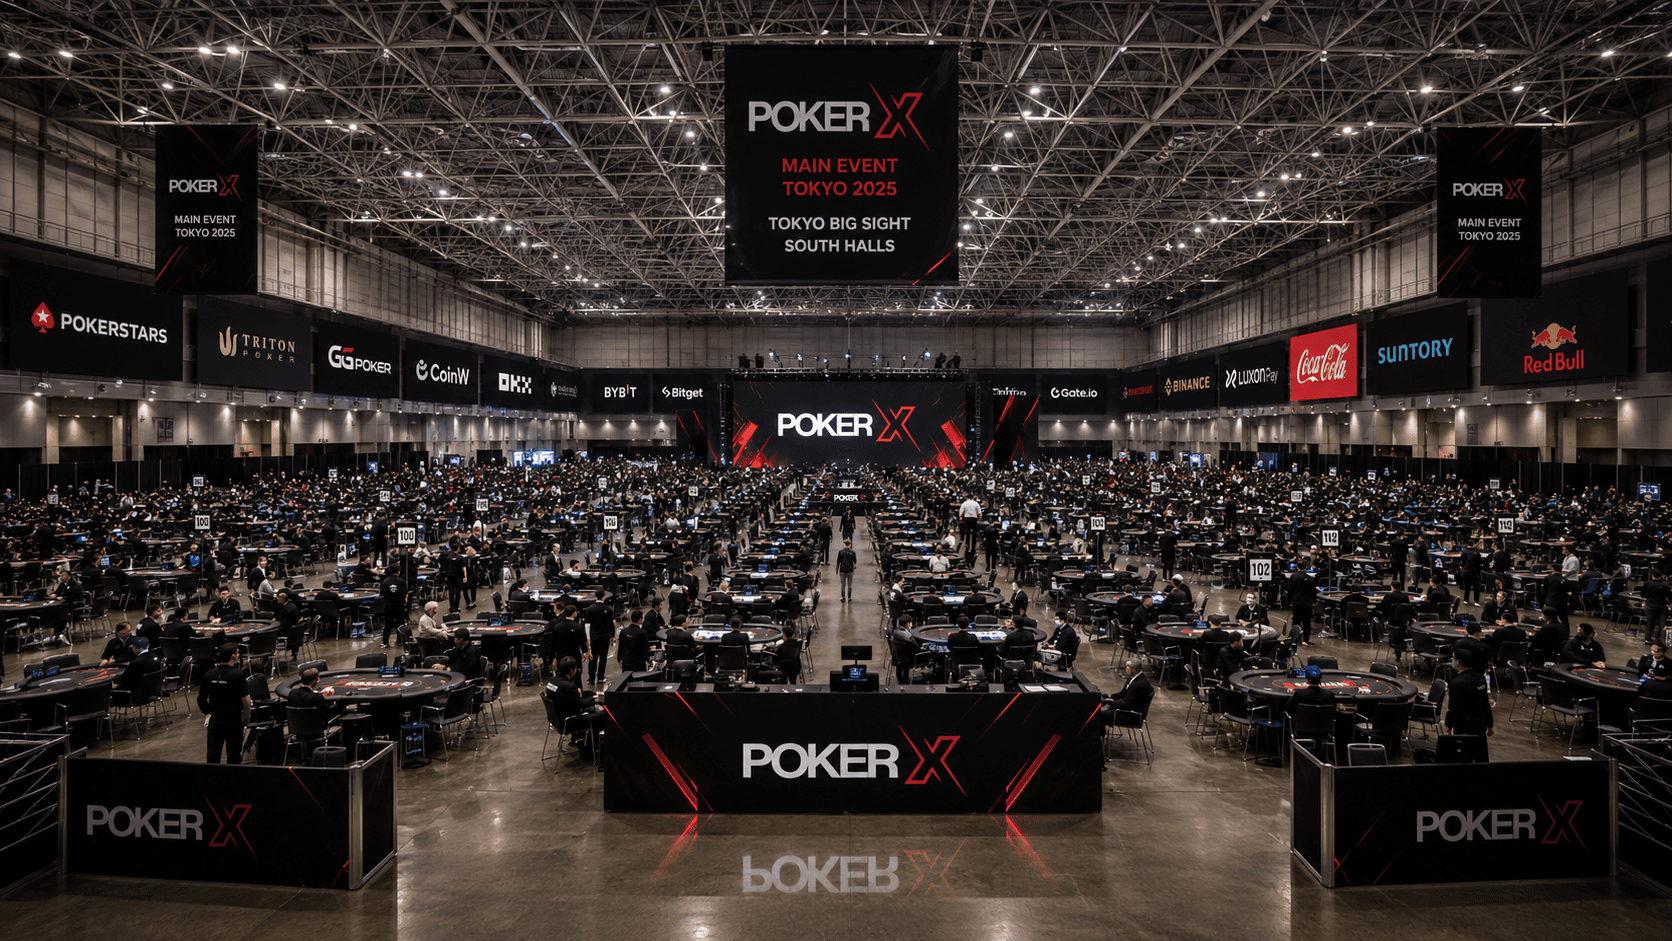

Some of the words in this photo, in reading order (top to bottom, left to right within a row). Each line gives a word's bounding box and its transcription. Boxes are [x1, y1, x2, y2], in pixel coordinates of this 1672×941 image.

[749, 101, 870, 132] POKER
[782, 158, 831, 173] MAIN
[837, 158, 899, 173] EVENT
[169, 179, 217, 193] POKER
[782, 181, 847, 196] TOKYO
[853, 181, 897, 196] 2025
[1452, 183, 1503, 197] POKER
[174, 215, 200, 224] MAIN
[203, 215, 236, 224] EVENT
[768, 217, 825, 230] TOKYO
[830, 217, 857, 230] BIG
[862, 217, 911, 230] SIGHT
[1457, 218, 1485, 227] MAIN
[1488, 218, 1522, 227] EVENT
[175, 228, 209, 237] TOKYO
[211, 228, 236, 237] 2025
[1458, 231, 1494, 241] TOKYO
[1496, 231, 1521, 241] 2025
[784, 239, 840, 252] SOUTH
[844, 239, 895, 252] HALLS
[61, 313, 168, 344] POKERSTARS
[242, 333, 296, 353] TRITON
[243, 350, 295, 363] POKER
[1378, 337, 1453, 364] SUNTORY
[1524, 352, 1553, 374] Red
[1555, 349, 1585, 371] Bull
[430, 363, 470, 386] CoinW
[499, 372, 532, 394] OKX
[1173, 375, 1211, 392] BINANCE
[604, 384, 637, 398] BYBIT
[672, 387, 704, 400] Bitget
[1061, 387, 1098, 398] Gate.io
[777, 413, 873, 436] POKER
[400, 530, 414, 541] 100
[1324, 532, 1338, 543] 112
[1252, 563, 1270, 576] 102
[743, 743, 898, 779] POKER
[86, 805, 204, 841] POKER
[1416, 809, 1536, 843] POKER
